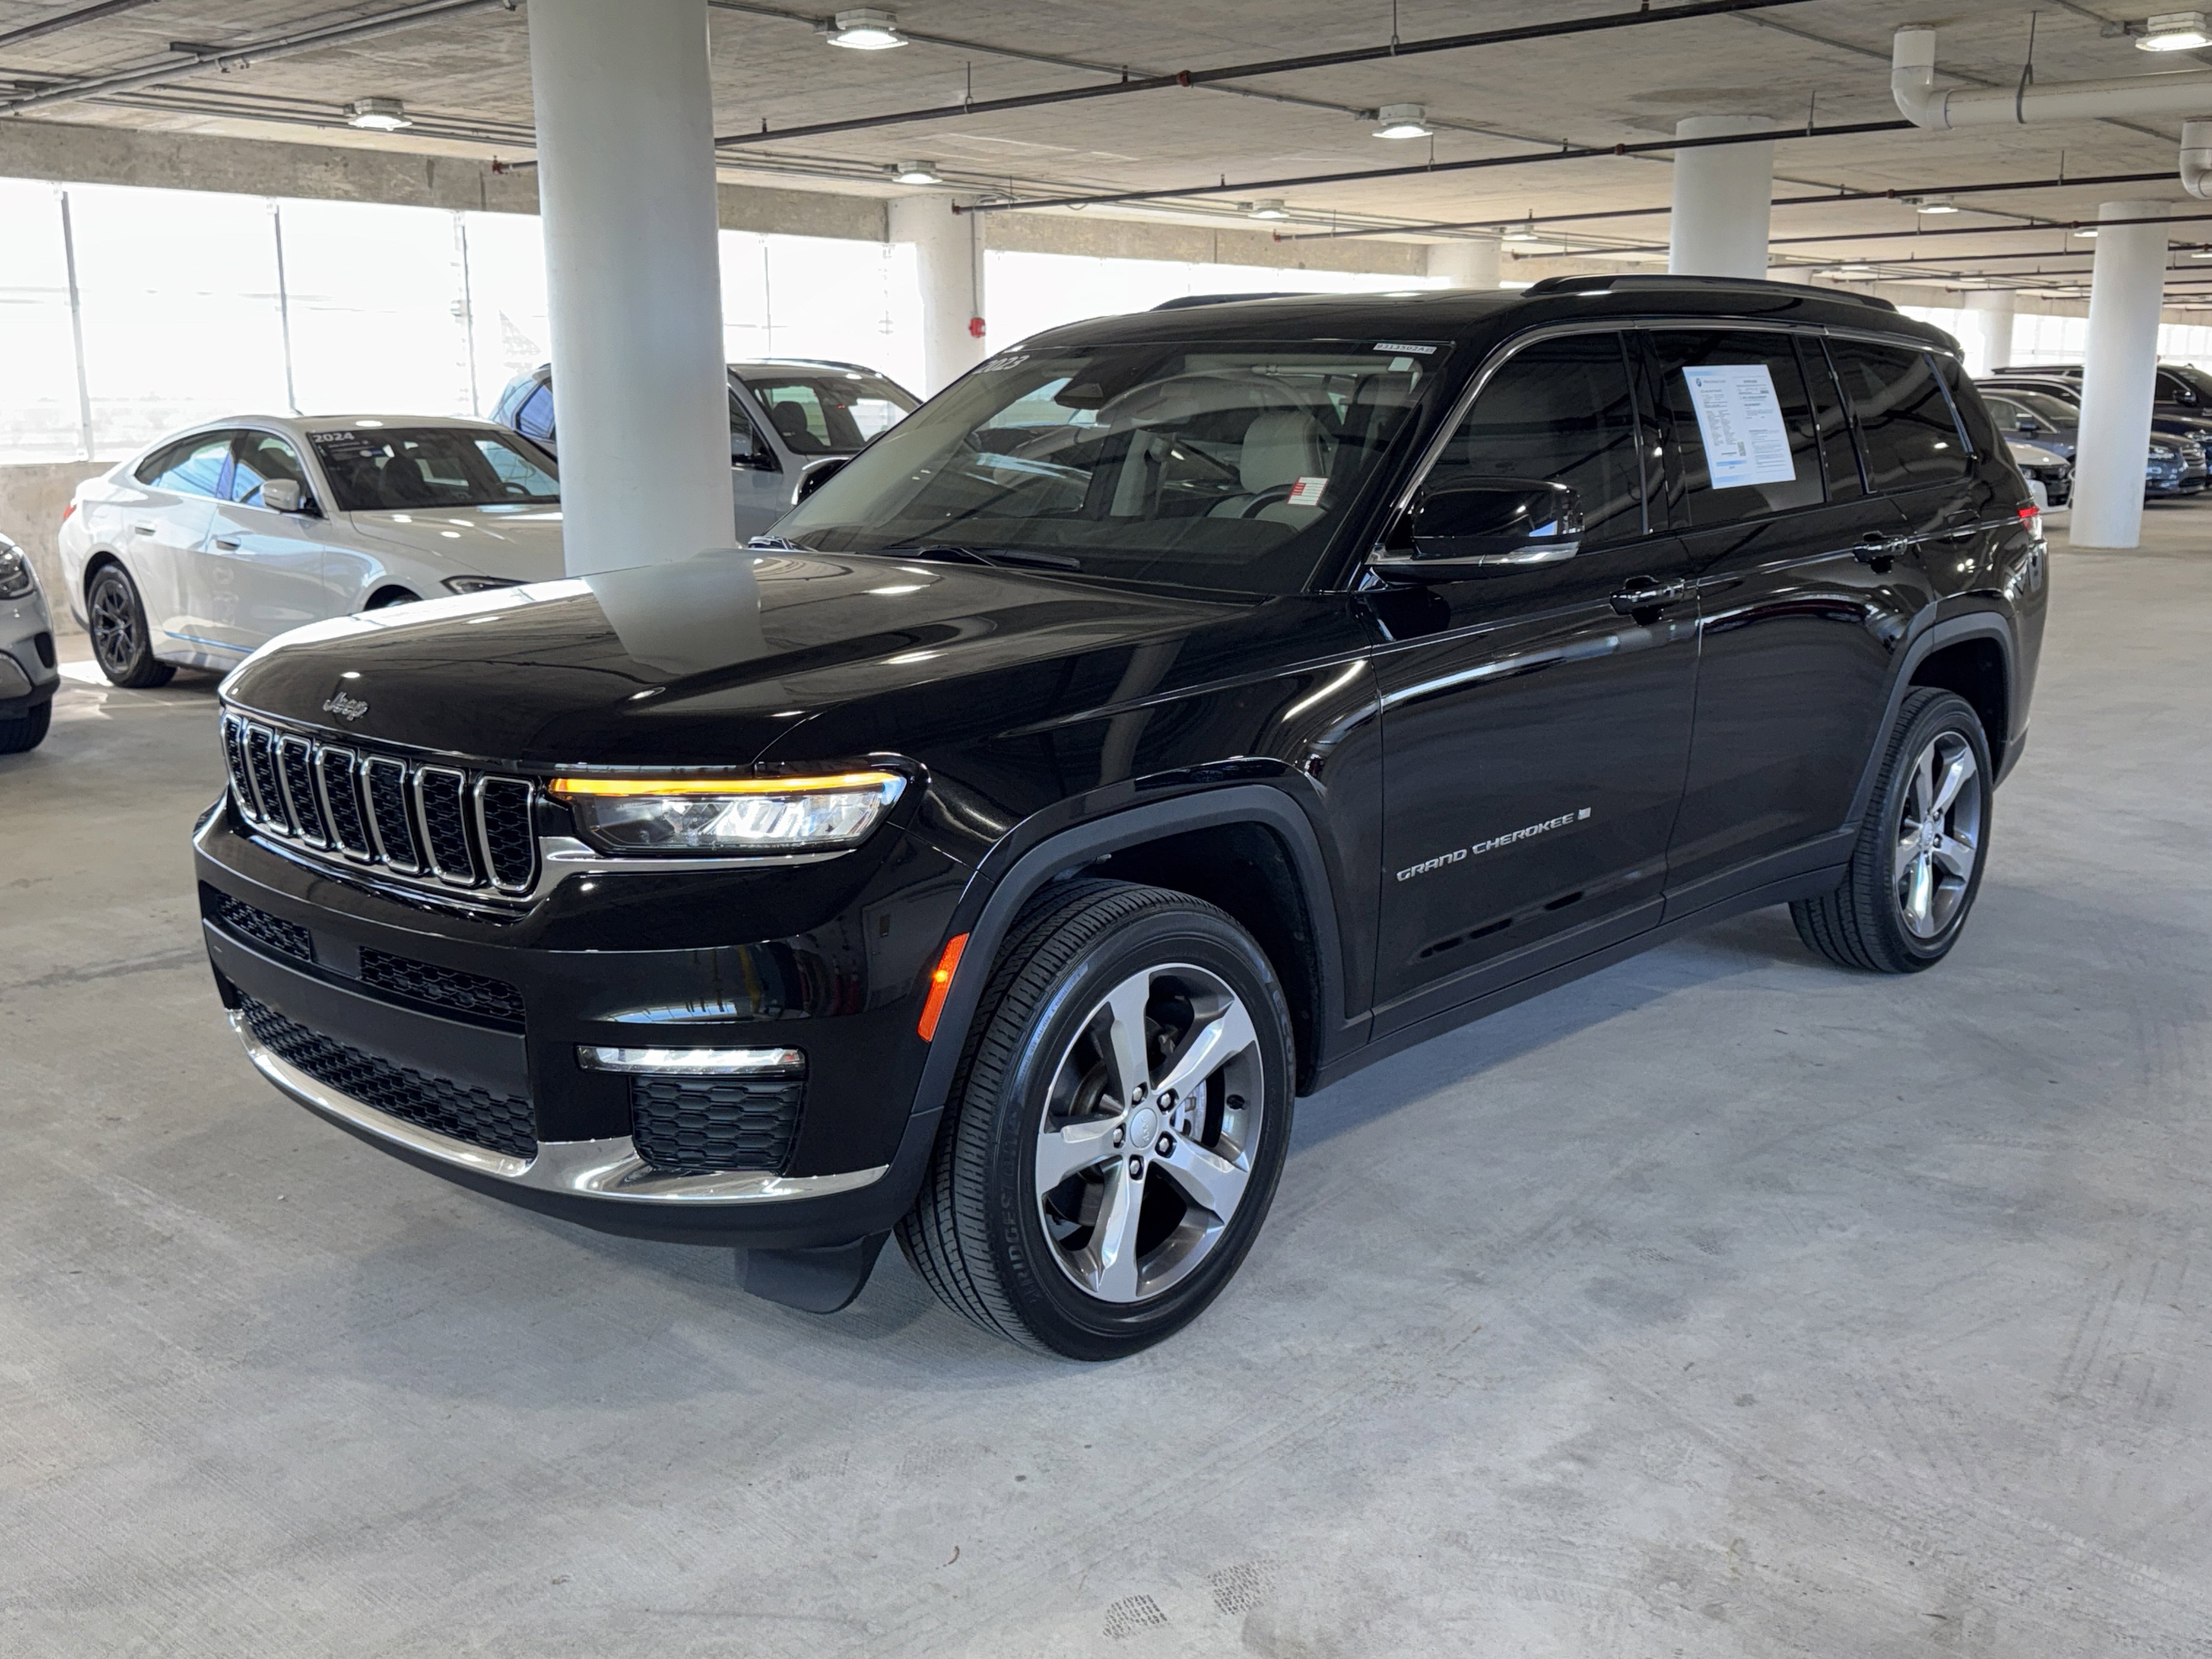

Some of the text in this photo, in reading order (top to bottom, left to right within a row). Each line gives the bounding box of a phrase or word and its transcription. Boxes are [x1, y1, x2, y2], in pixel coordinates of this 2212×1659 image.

[972, 354, 1030, 375] 2023
[313, 432, 356, 443] 2024
[323, 691, 369, 721] Jeep
[1396, 812, 1575, 882] GRAND CHEROKEE
